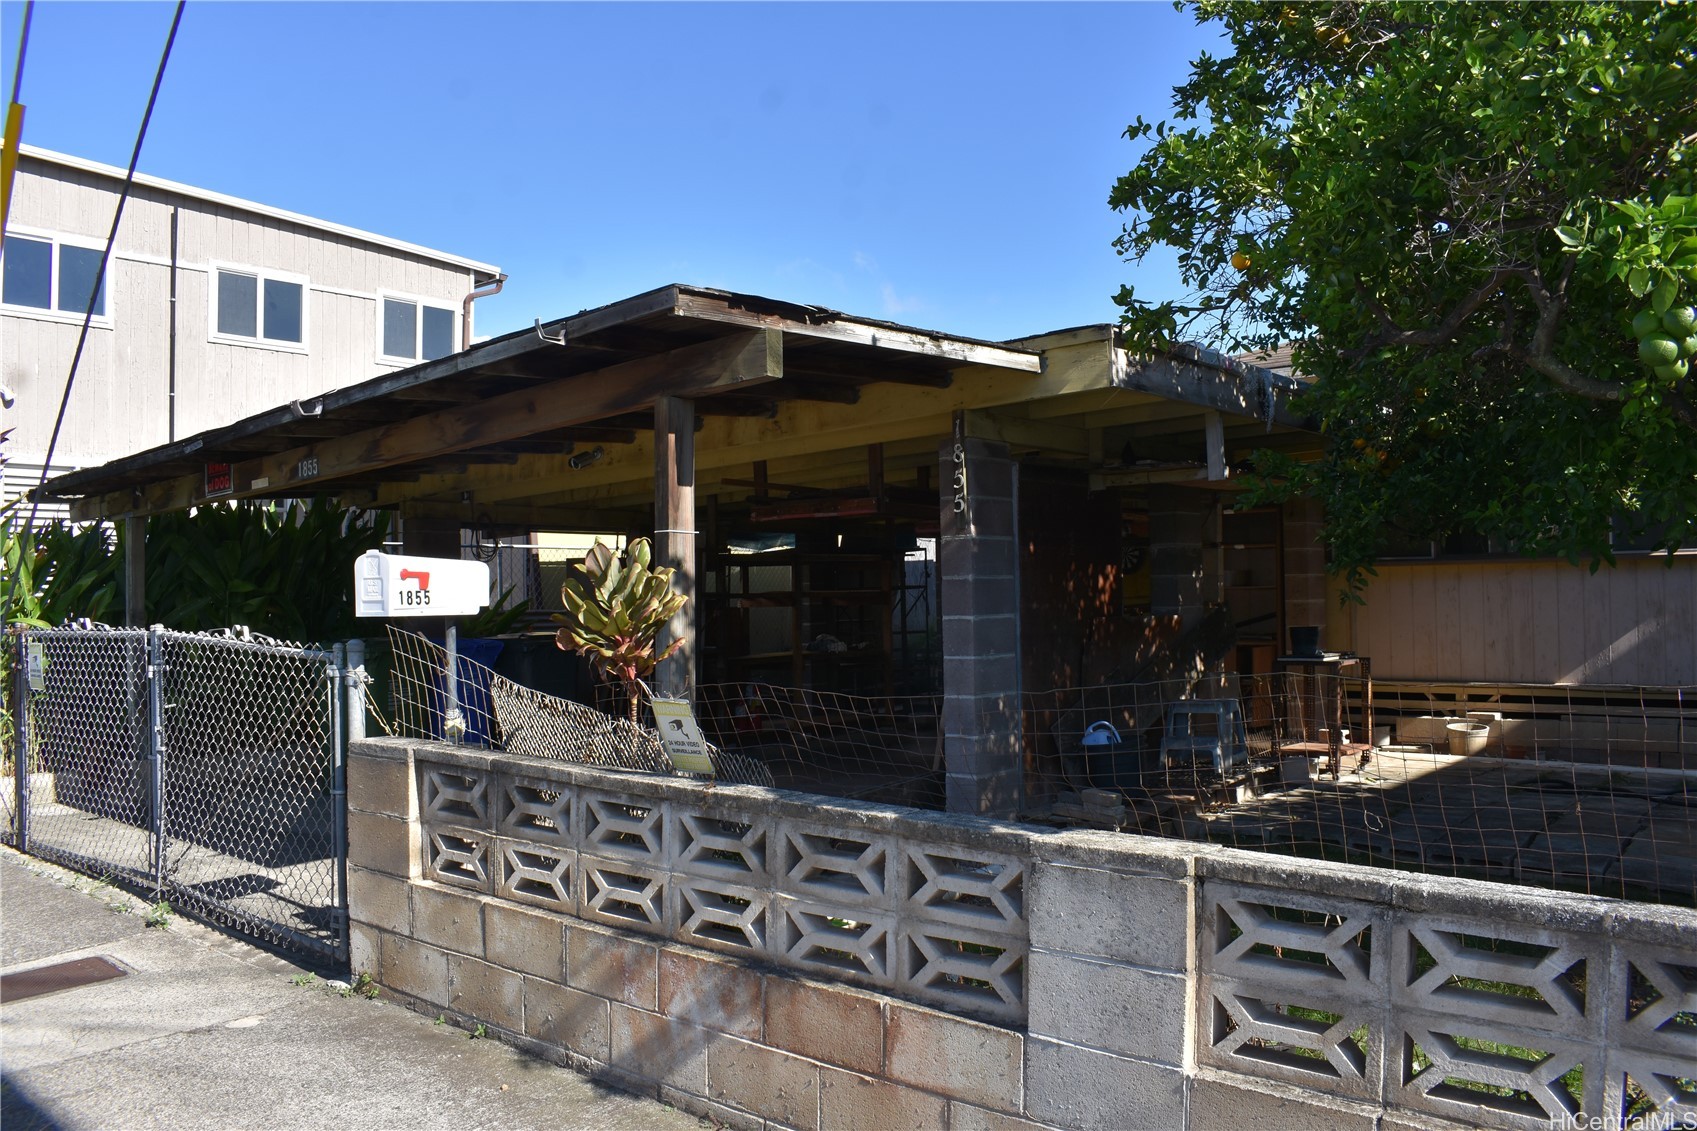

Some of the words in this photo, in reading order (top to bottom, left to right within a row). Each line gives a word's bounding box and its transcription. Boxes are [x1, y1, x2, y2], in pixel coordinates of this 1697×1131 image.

[299, 458, 318, 477] 1855
[953, 419, 966, 512] 1855
[214, 475, 230, 490] DOG
[399, 590, 431, 606] 1855
